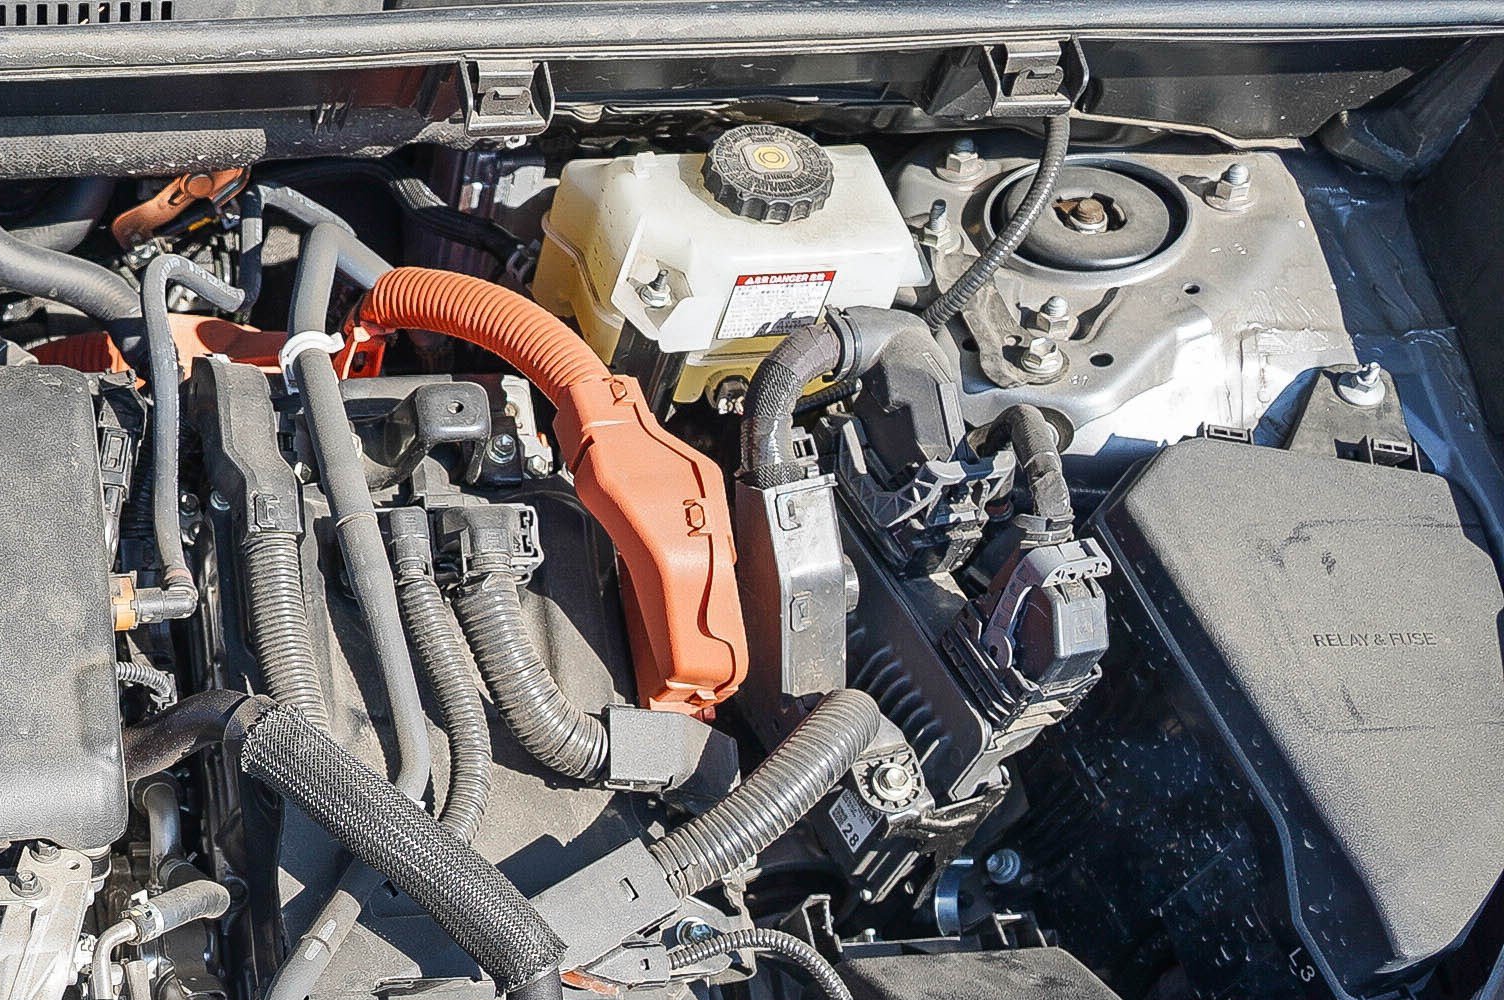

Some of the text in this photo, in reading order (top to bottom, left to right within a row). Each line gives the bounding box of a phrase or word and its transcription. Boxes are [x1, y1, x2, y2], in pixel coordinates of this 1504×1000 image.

[769, 274, 809, 284] DANGER
[1312, 632, 1438, 647] RELAY & FUSE
[842, 822, 860, 847] 28
